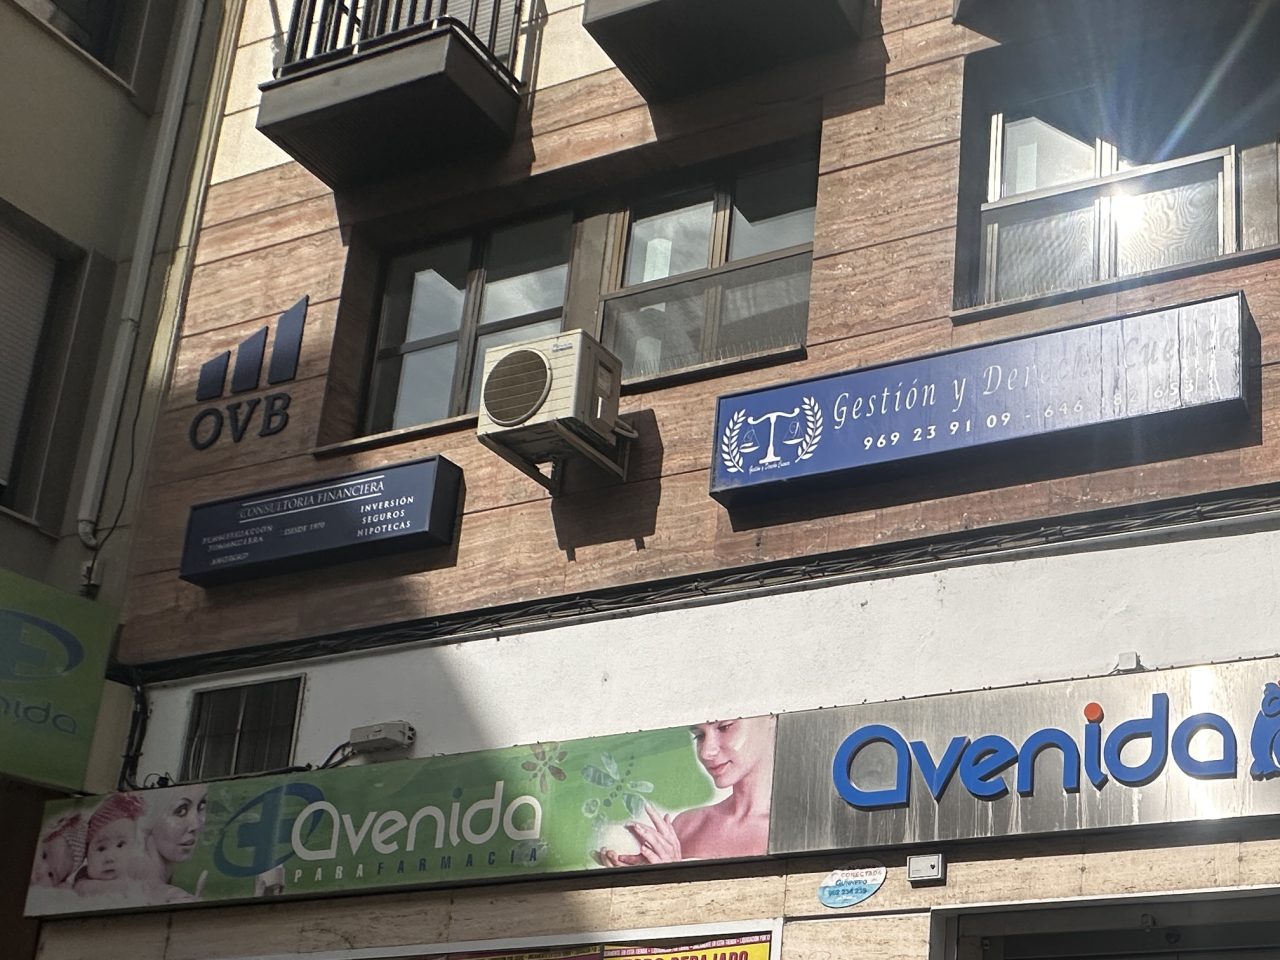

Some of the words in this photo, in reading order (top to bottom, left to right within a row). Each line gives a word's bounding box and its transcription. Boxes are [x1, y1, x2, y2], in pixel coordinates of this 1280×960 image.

[832, 380, 937, 430] Gestión
[951, 377, 968, 411] y
[189, 392, 290, 451] OVB
[863, 430, 900, 451] 969
[913, 424, 937, 442] 23
[950, 419, 972, 436] 91
[986, 411, 1012, 429] 09
[317, 481, 384, 503] FINANCIERA
[360, 495, 414, 513] INVERSIÓN
[357, 520, 411, 537] HIPOTECAS
[362, 509, 405, 524] SEGUROS
[293, 847, 539, 883] PARAFARMACIA
